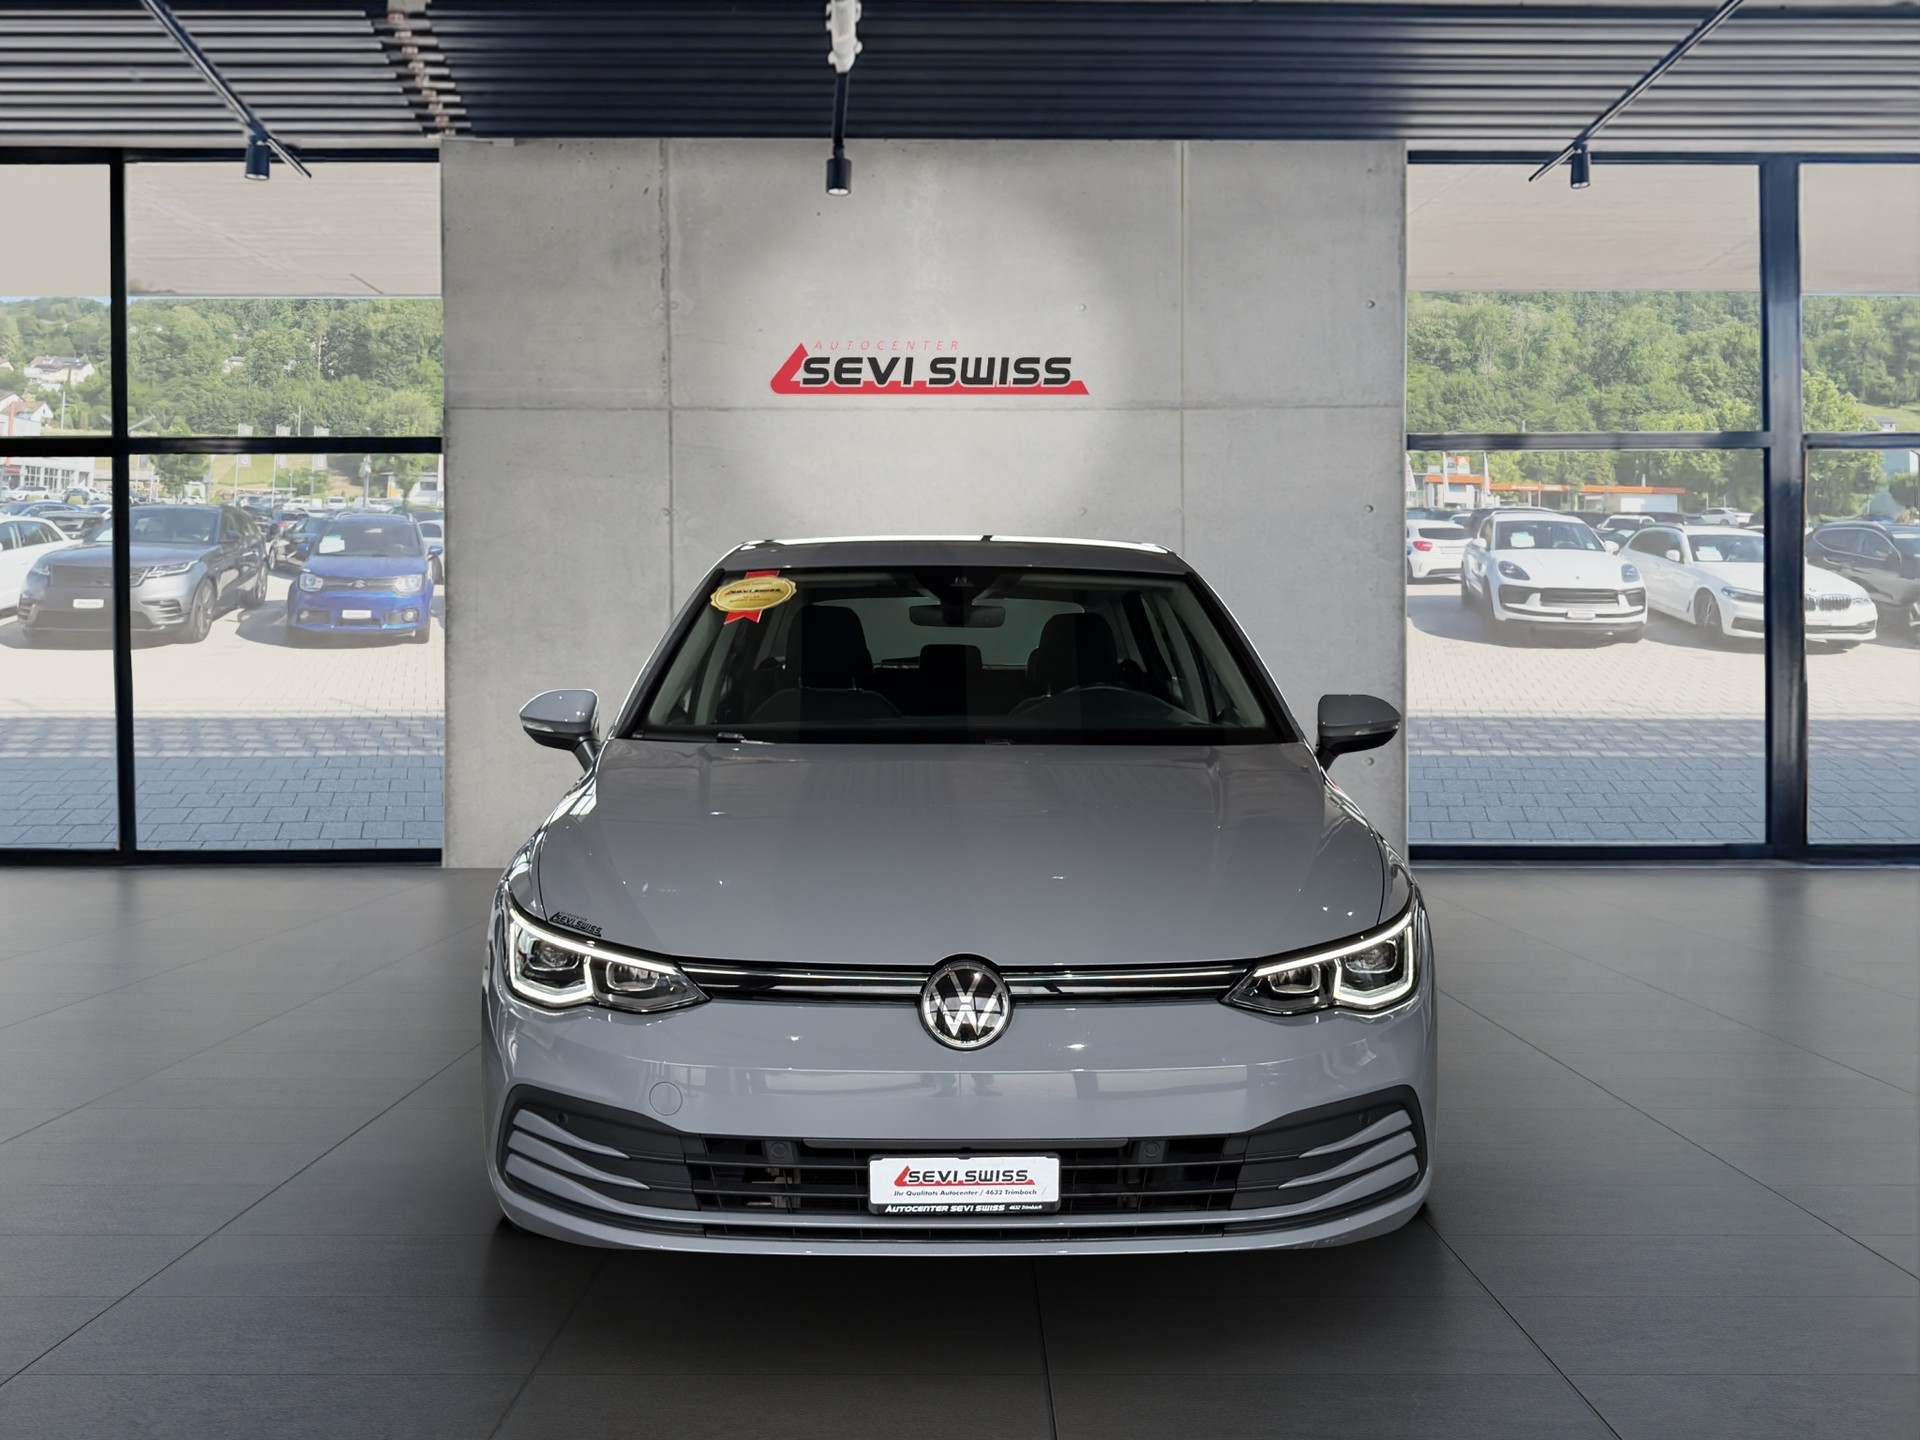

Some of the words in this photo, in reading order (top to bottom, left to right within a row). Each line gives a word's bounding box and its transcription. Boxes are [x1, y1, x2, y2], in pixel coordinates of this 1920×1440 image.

[813, 340, 960, 351] AUTOCENTER
[802, 357, 914, 386] SEVI
[928, 357, 1072, 386] SWISS
[555, 914, 576, 926] SEVI
[575, 919, 602, 934] SWISS
[908, 1170, 958, 1183] SEVI
[964, 1169, 1028, 1182] SWISS
[950, 1204, 974, 1212] SEVI
[975, 1204, 1006, 1212] SWISS
